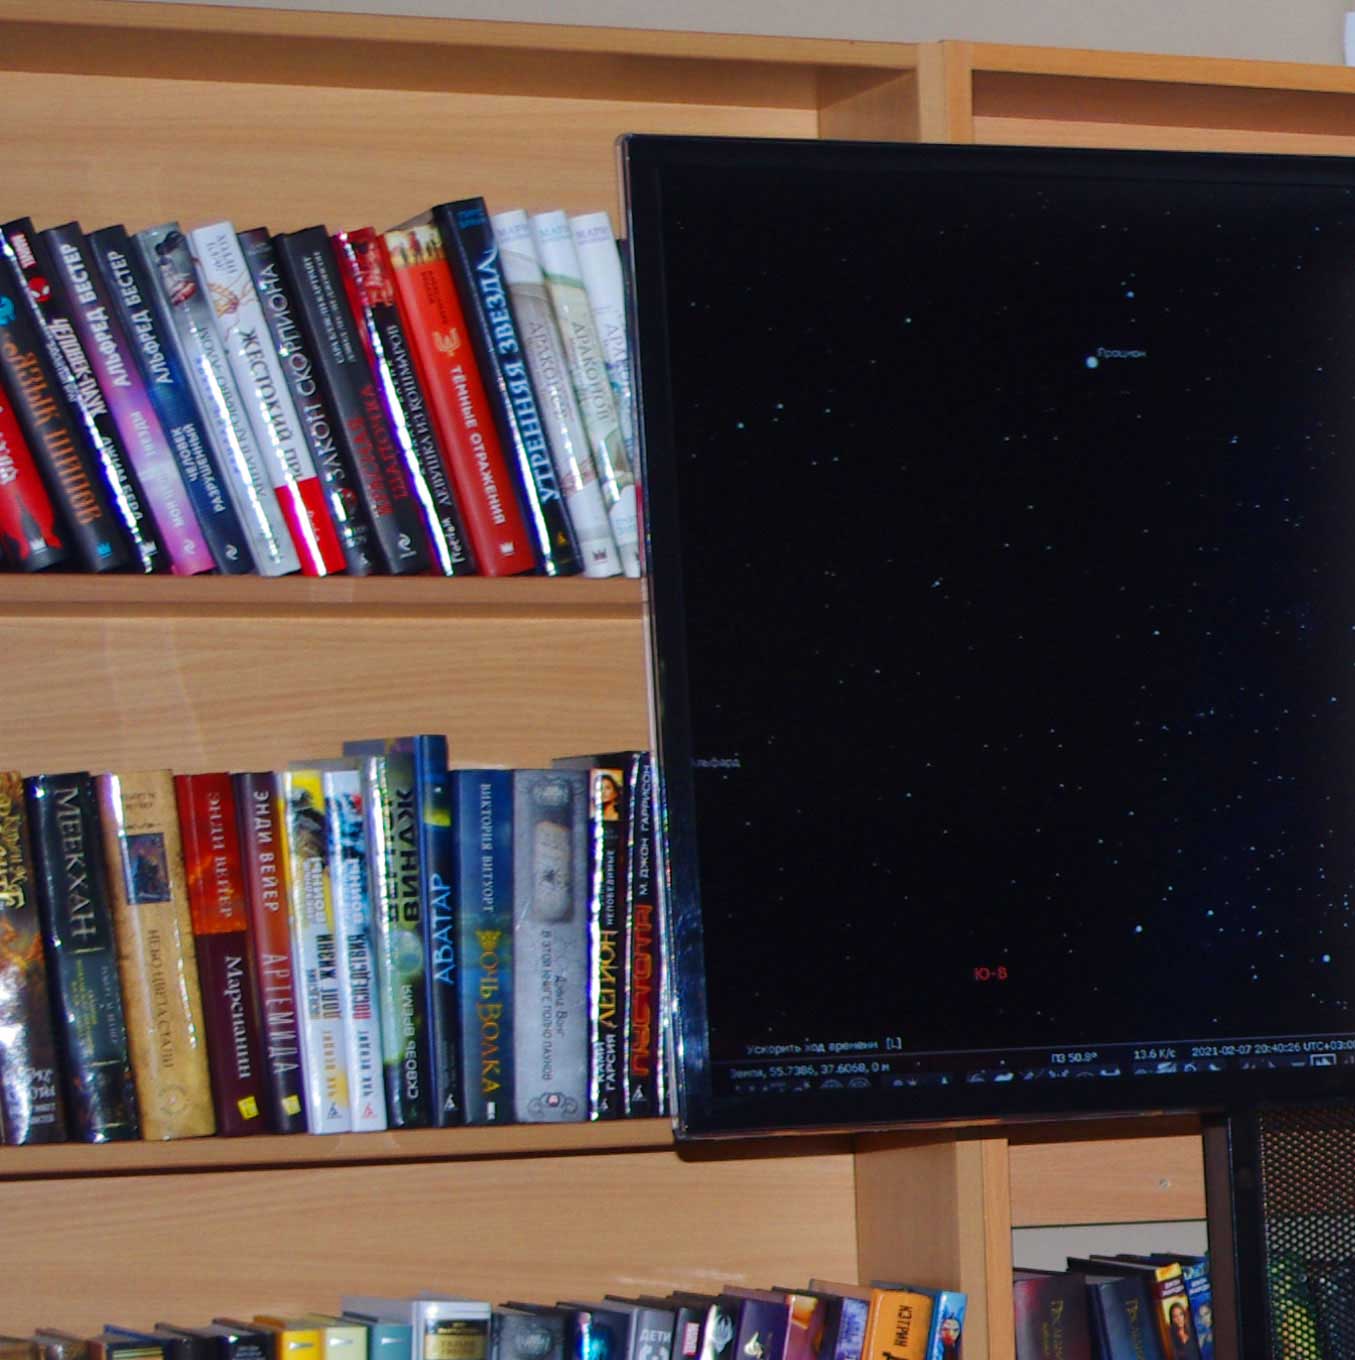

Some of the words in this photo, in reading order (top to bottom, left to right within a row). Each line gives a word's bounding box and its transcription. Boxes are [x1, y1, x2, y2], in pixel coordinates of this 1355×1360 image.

[59, 240, 96, 304] БЕСТЕР
[107, 248, 140, 307] БЕСТЕР
[476, 246, 522, 354] ЗВЕЗДА
[48, 316, 107, 417] ЧЕЛОВЕК-ПАУК
[83, 306, 132, 391] АЛЬФРЕД
[130, 309, 172, 387] АЛЬФРЕД
[258, 262, 317, 397] СКОРПИОНА
[383, 323, 424, 410] КОШМАРОВ
[170, 426, 200, 482] ЧЕЛОВЕК
[305, 402, 345, 482] ЗАКОН
[411, 411, 430, 433] ИЗ
[502, 359, 559, 503] УТРЕННЯЯ
[42, 424, 100, 524] ШИПОВ
[183, 421, 226, 512] РАЗРУШЕННЫЙ
[416, 434, 453, 507] ДЕВУШКА
[468, 431, 506, 524] ОТРАЖЕНИЯ
[253, 790, 272, 843] ЭНДИ
[479, 784, 492, 850] ВИКТОРИЯ
[640, 764, 651, 831] ГАРРИСОН
[54, 786, 96, 937] МЕЕКХАН
[257, 851, 280, 912] ВЕЙЕР
[481, 855, 494, 912] ВИТУОРТ
[639, 838, 648, 877] ДЖОН
[425, 873, 455, 984] АВАТАР
[260, 952, 299, 1074] АРТЕМИДА
[348, 933, 371, 1019] ПОСЛЕДСТВИЯ
[400, 984, 415, 1036] ВРЕМЯ
[222, 955, 255, 1079] Марсианин
[404, 1040, 419, 1098] СКВОЗЬ
[605, 1033, 617, 1090] ГАРСИЯ
[639, 1328, 669, 1341] ДЕТИ
[894, 1304, 912, 1347] КЭТРИН
